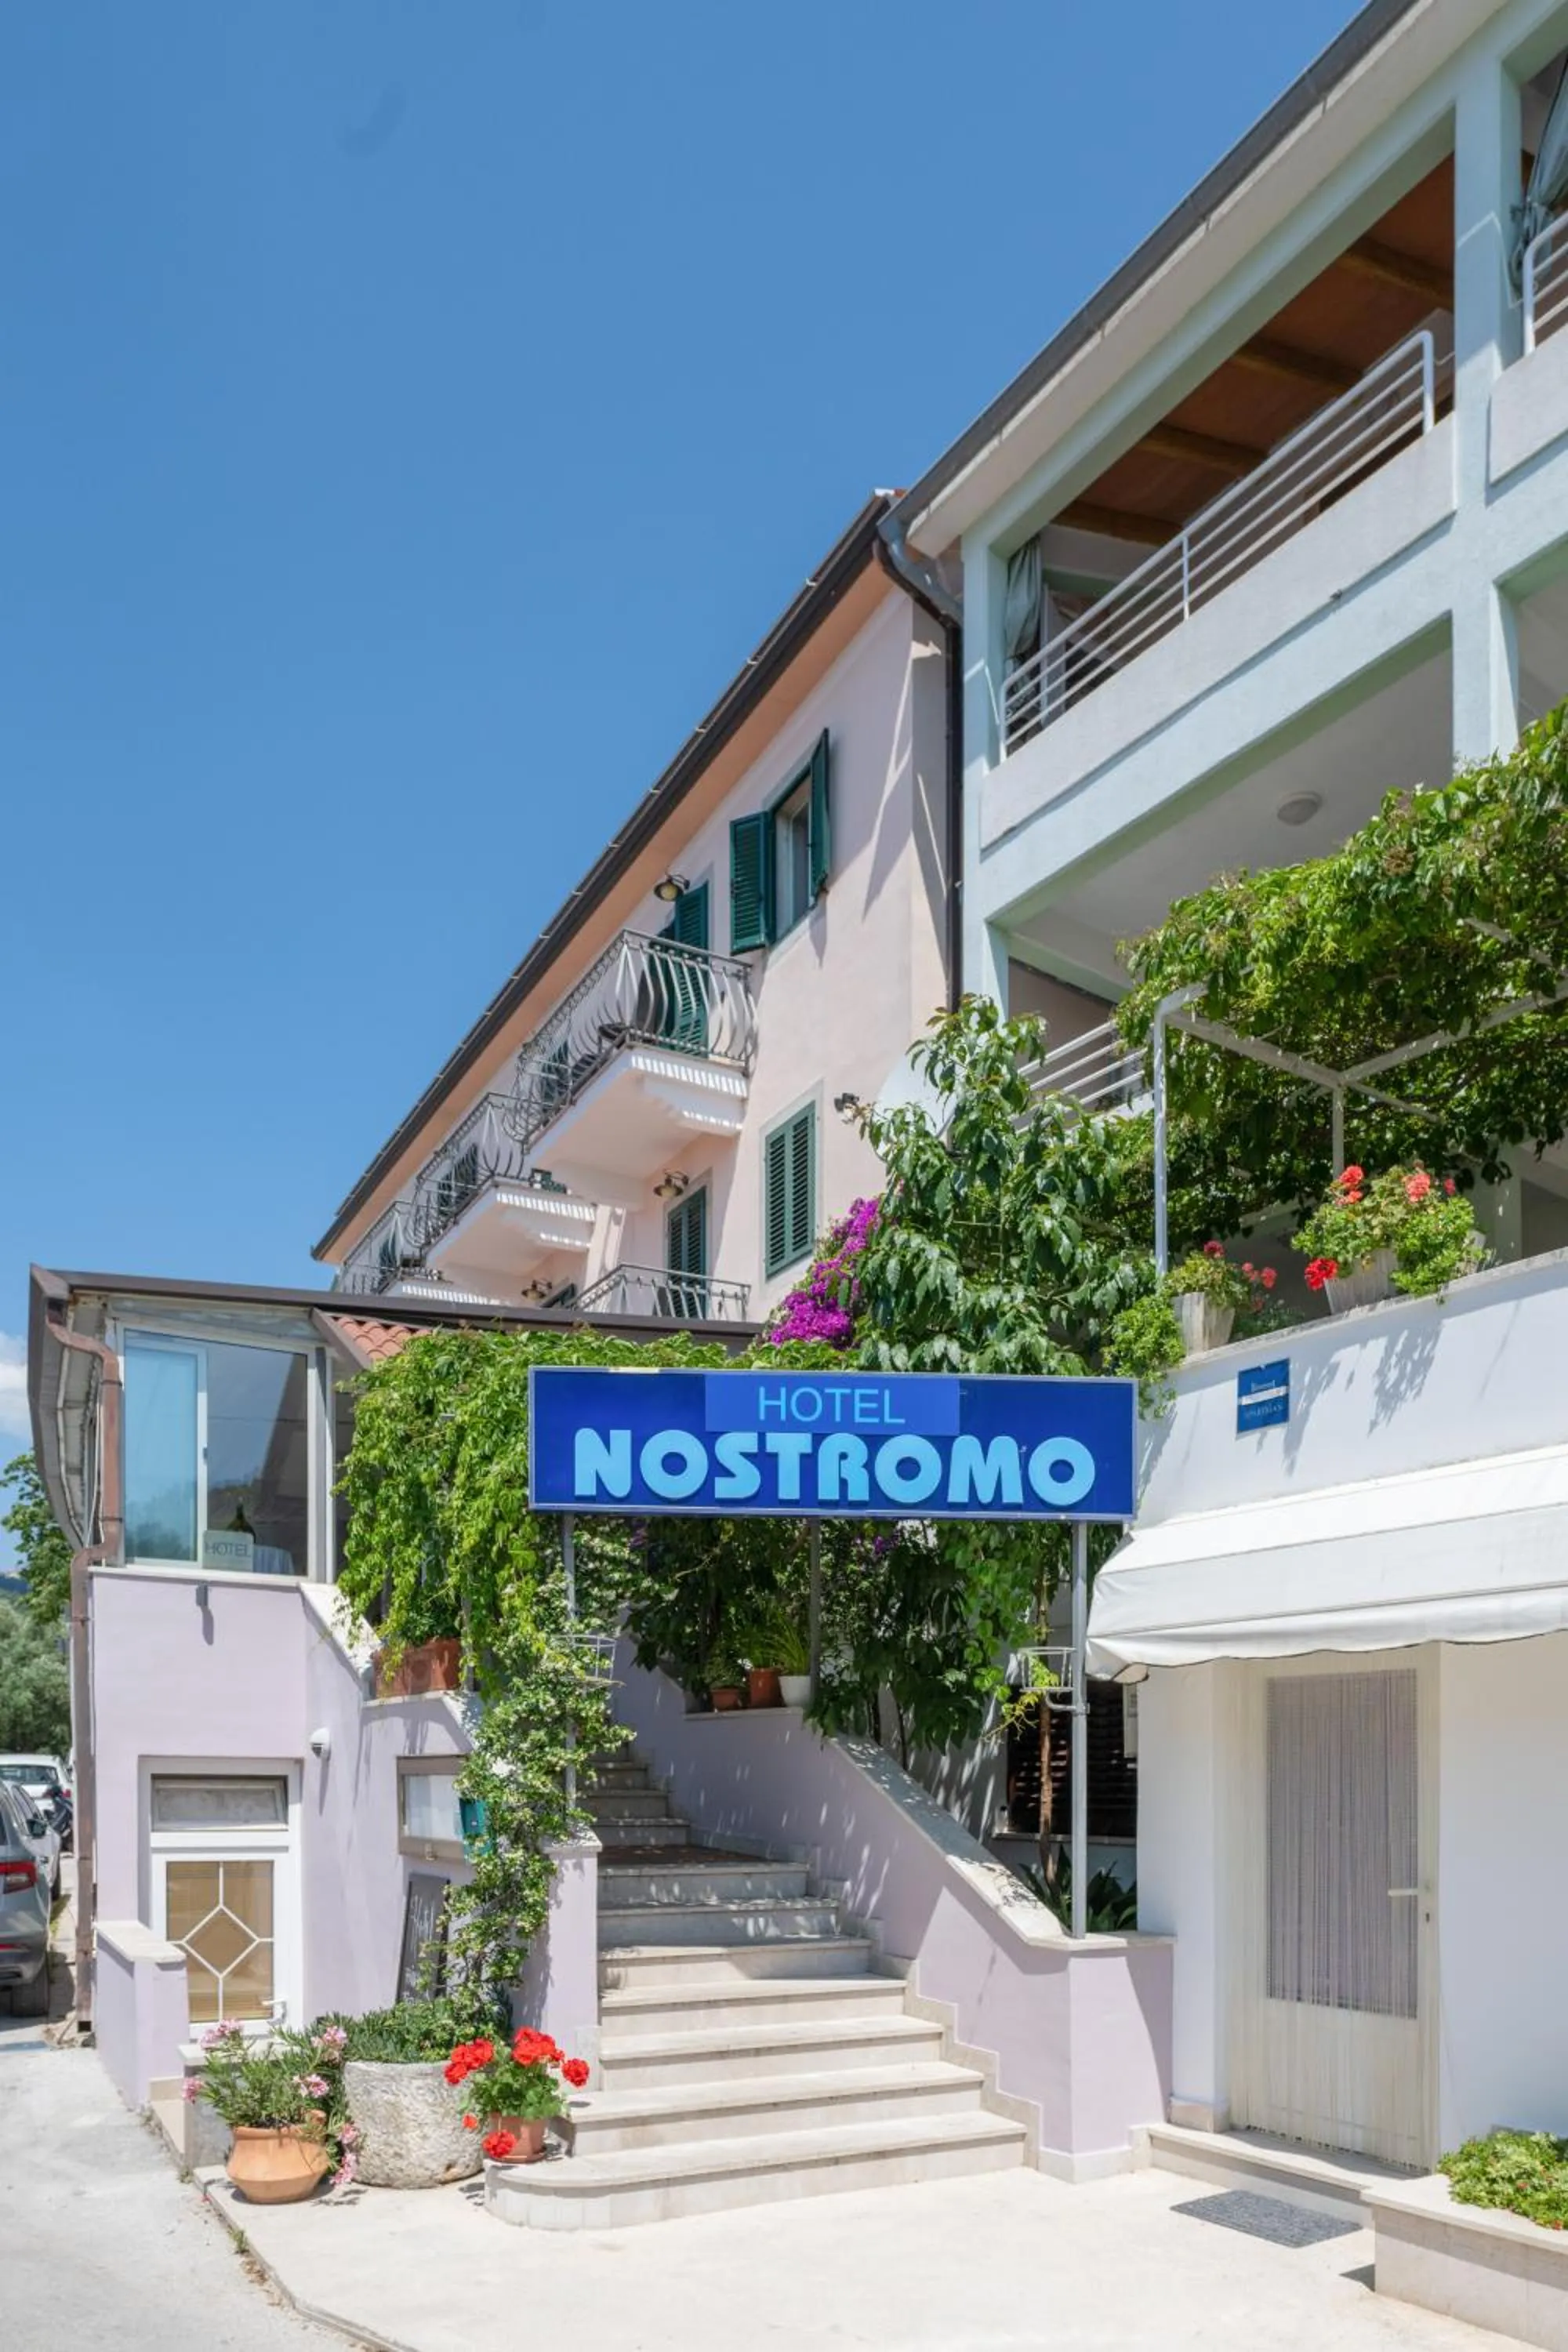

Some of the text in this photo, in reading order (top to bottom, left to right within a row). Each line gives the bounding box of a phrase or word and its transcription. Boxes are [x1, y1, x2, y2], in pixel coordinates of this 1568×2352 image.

[758, 1386, 906, 1424] HOTEL
[574, 1427, 1095, 1506] NOSTROMO
[205, 1541, 251, 1557] HOTEL
